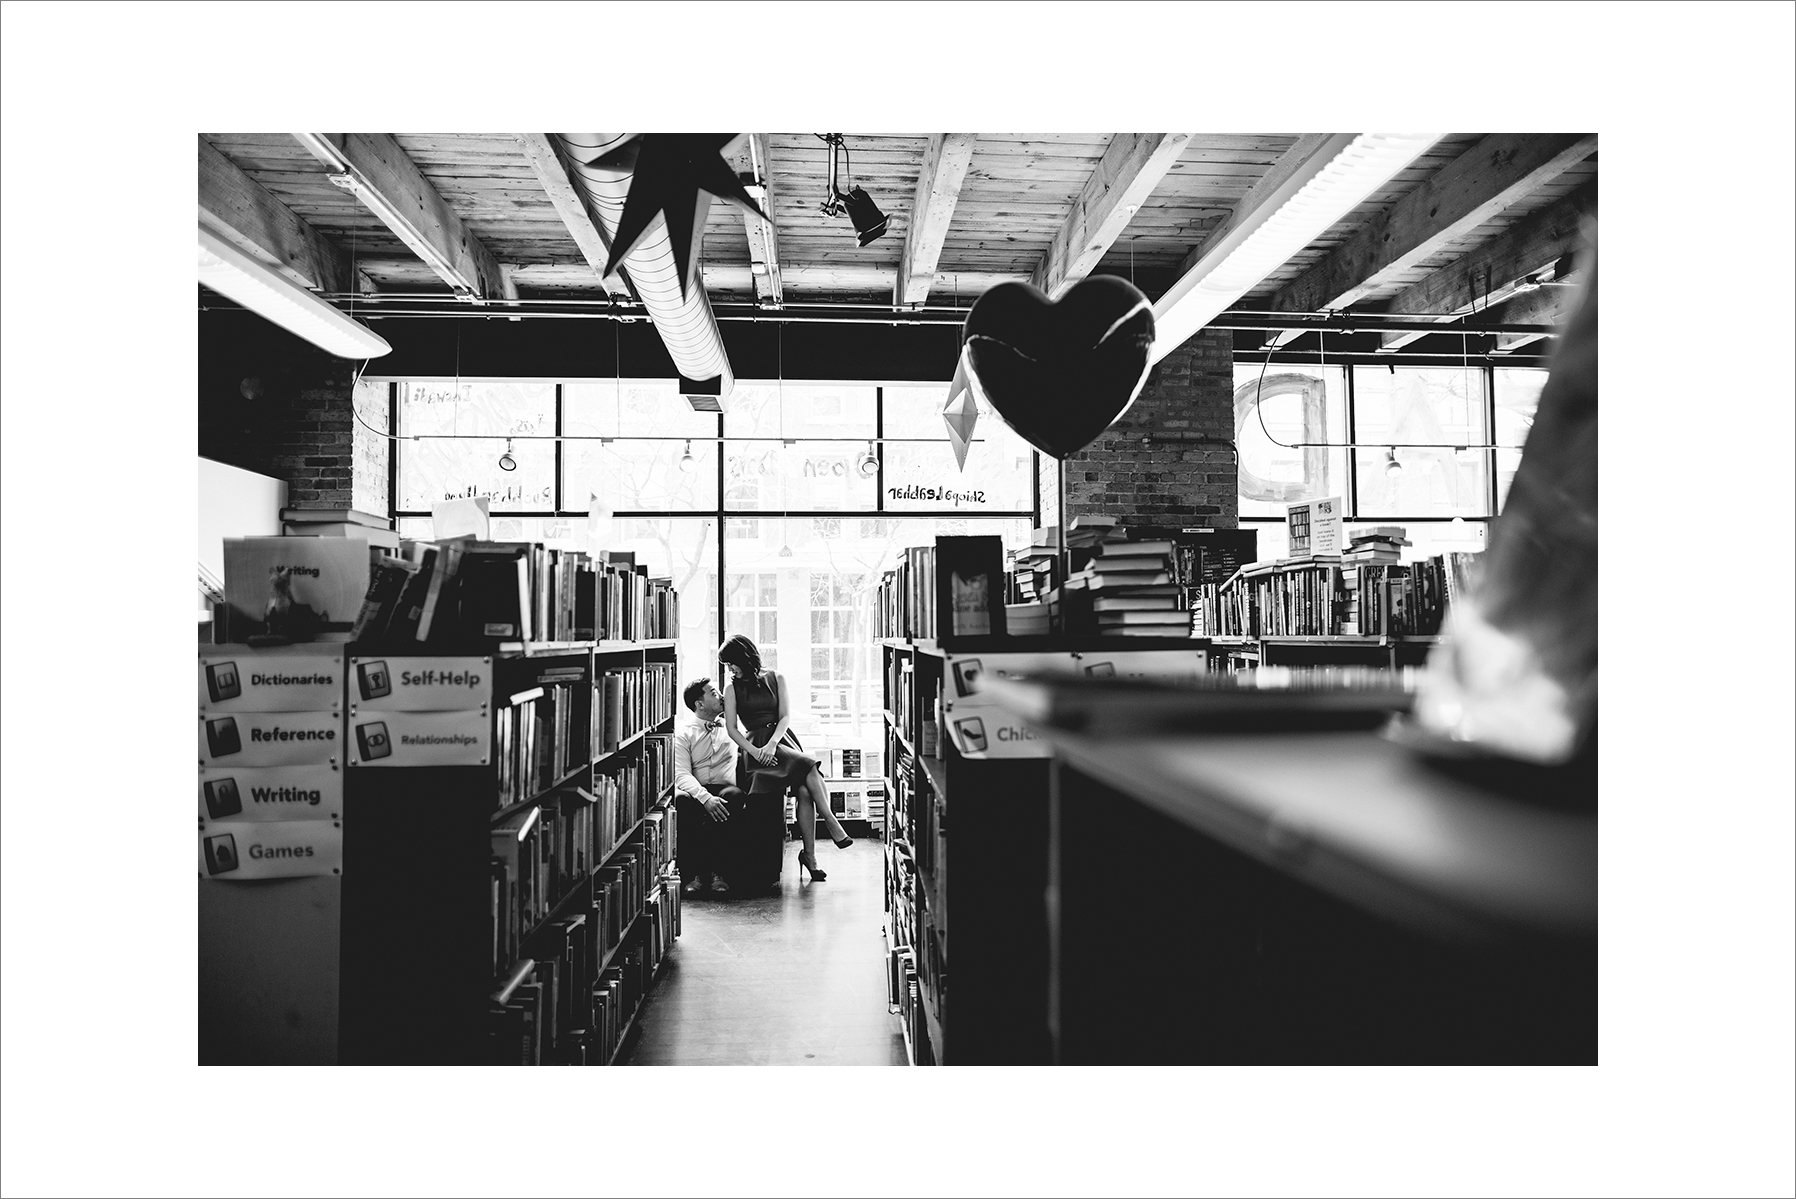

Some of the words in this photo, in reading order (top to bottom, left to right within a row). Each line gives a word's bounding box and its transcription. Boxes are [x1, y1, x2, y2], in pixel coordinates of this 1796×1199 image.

[276, 565, 320, 578] Writing
[251, 673, 333, 687] Dictionaries
[401, 670, 481, 688] Self-Help
[251, 727, 336, 743] Reference
[401, 733, 479, 747] Relationships
[996, 725, 1042, 742] Chic
[251, 786, 321, 806] Writing
[248, 843, 314, 860] Games
